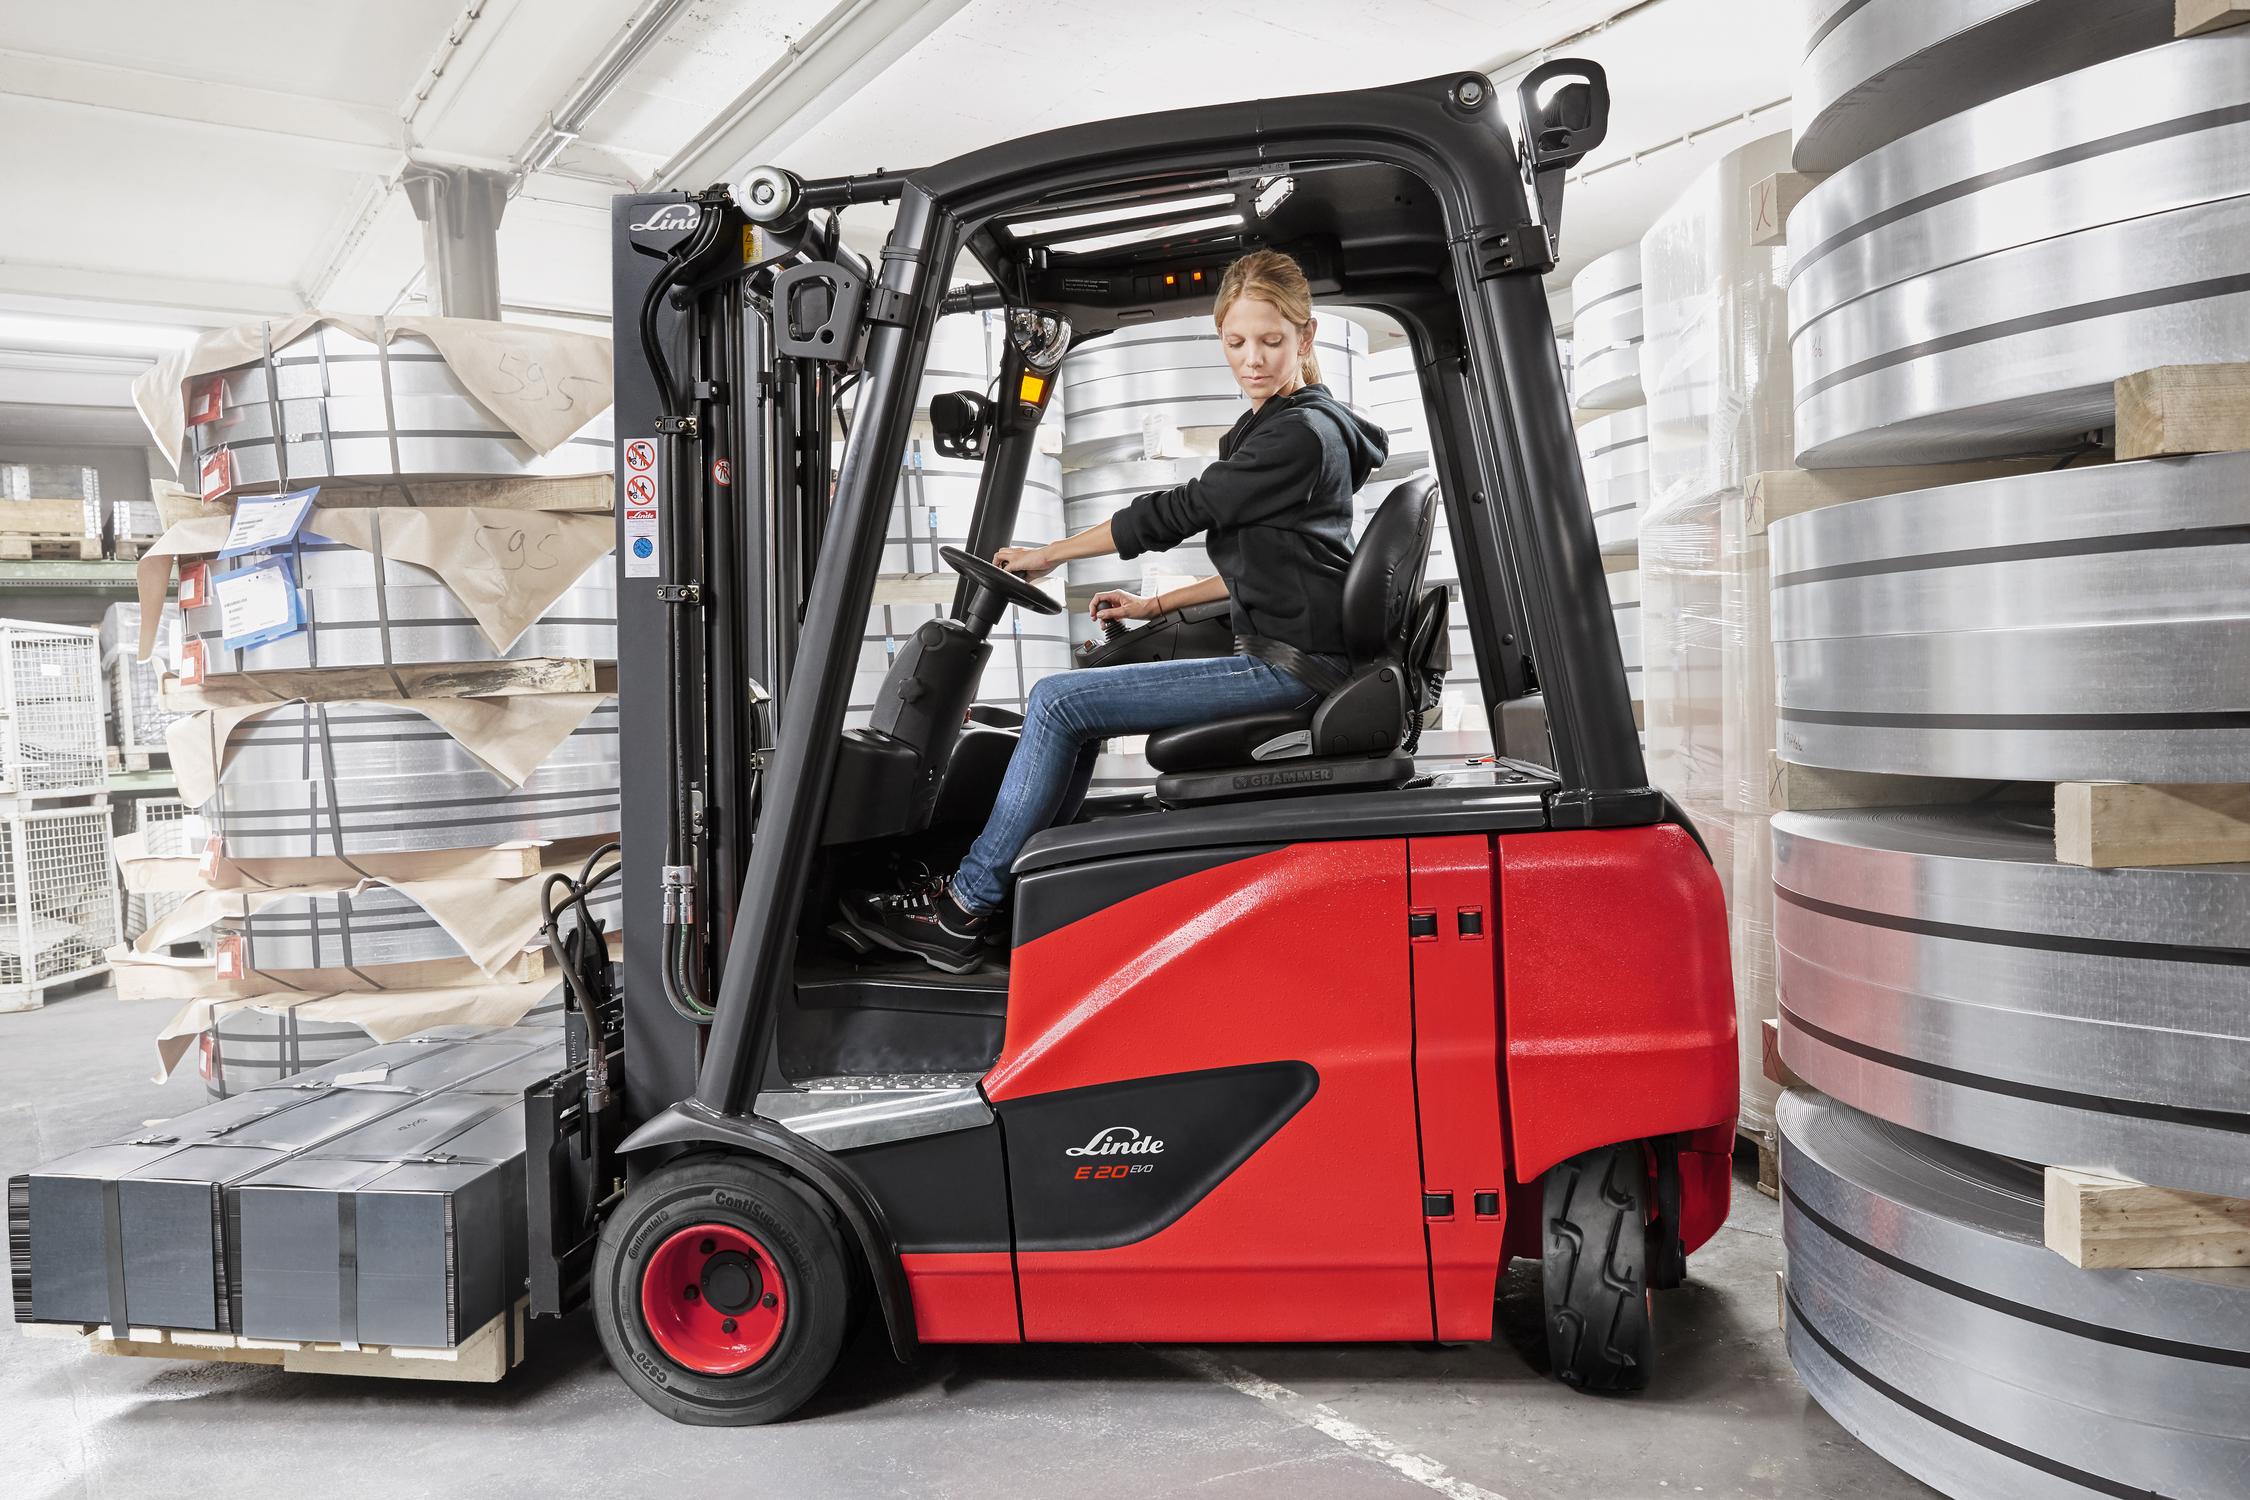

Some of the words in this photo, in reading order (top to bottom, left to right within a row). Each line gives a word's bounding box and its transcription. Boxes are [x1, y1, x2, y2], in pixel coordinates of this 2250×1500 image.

[630, 204, 700, 231] Lind
[1251, 768, 1332, 785] GRAMMER
[1066, 1127, 1164, 1156] Linde
[1074, 1166, 1092, 1179] E
[1094, 1165, 1129, 1179] 20
[1130, 1165, 1153, 1173] EVO
[628, 1214, 664, 1259] Continental
[637, 1352, 667, 1384] CS20
